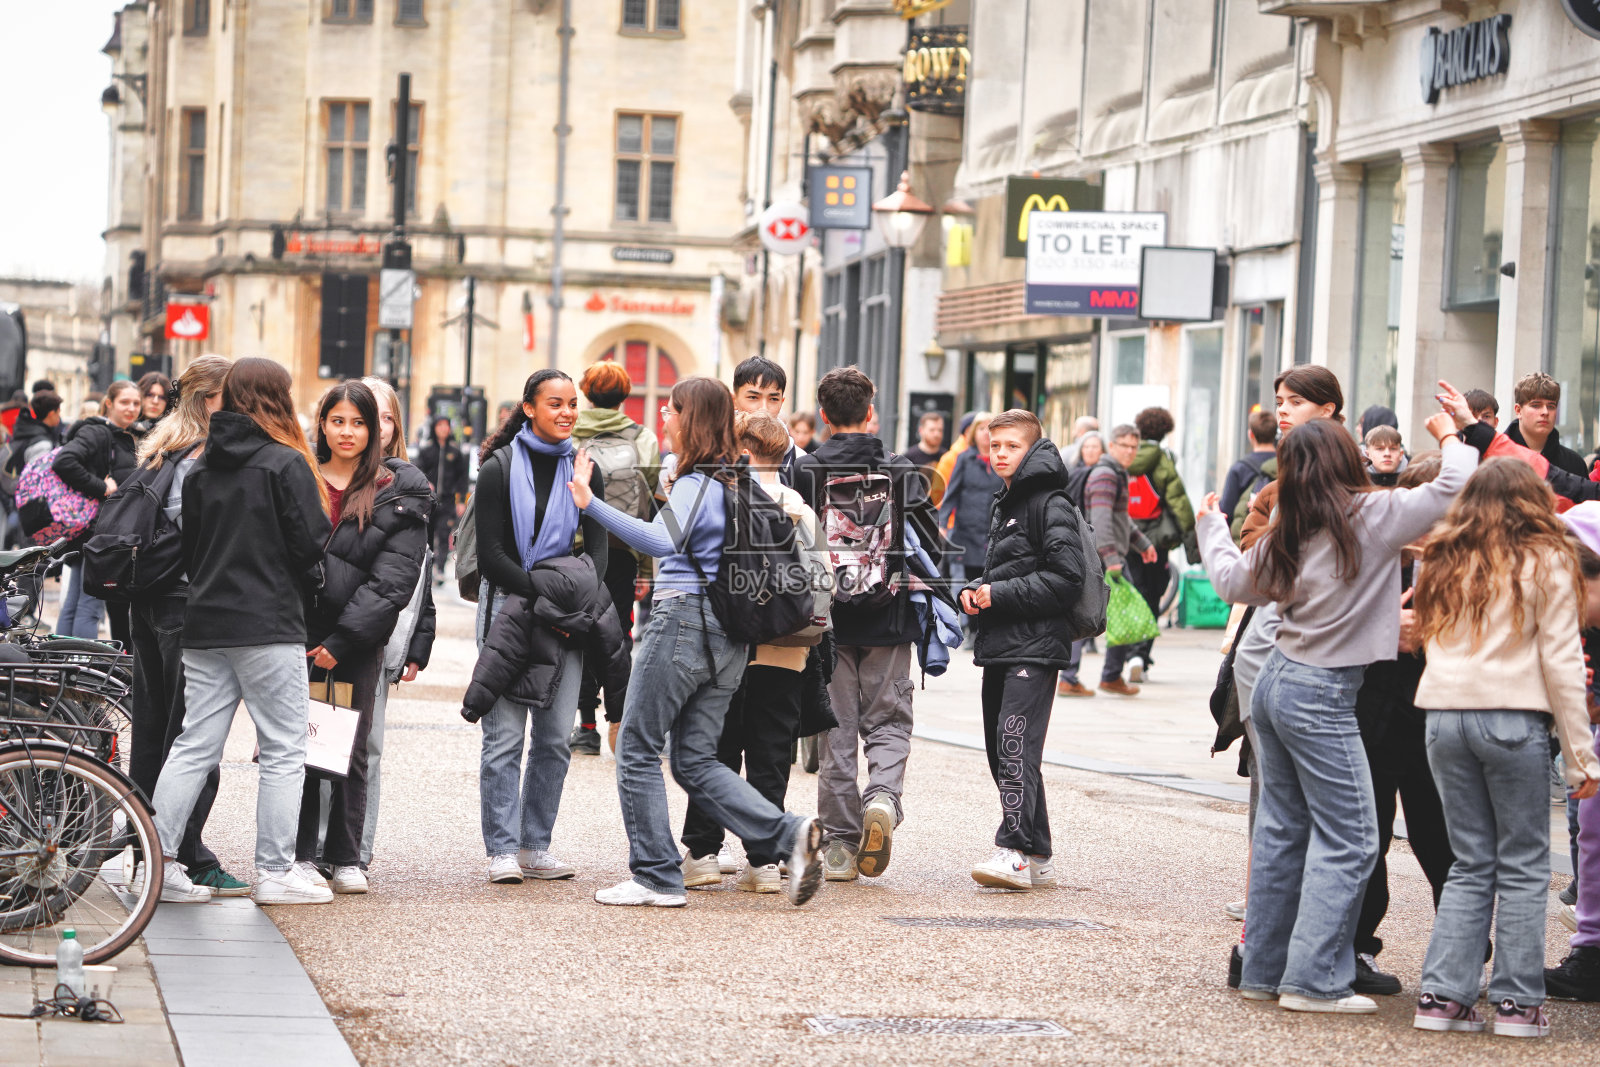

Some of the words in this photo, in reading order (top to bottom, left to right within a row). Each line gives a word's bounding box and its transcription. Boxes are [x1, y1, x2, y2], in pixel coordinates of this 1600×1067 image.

[1434, 14, 1506, 90] BARCLAYS
[1037, 219, 1116, 231] COMMERCIAL
[1121, 221, 1159, 232] SPACE
[1037, 233, 1072, 254] TO
[1081, 234, 1132, 255] LET
[610, 294, 695, 316] Santander
[999, 714, 1027, 832] adidas
